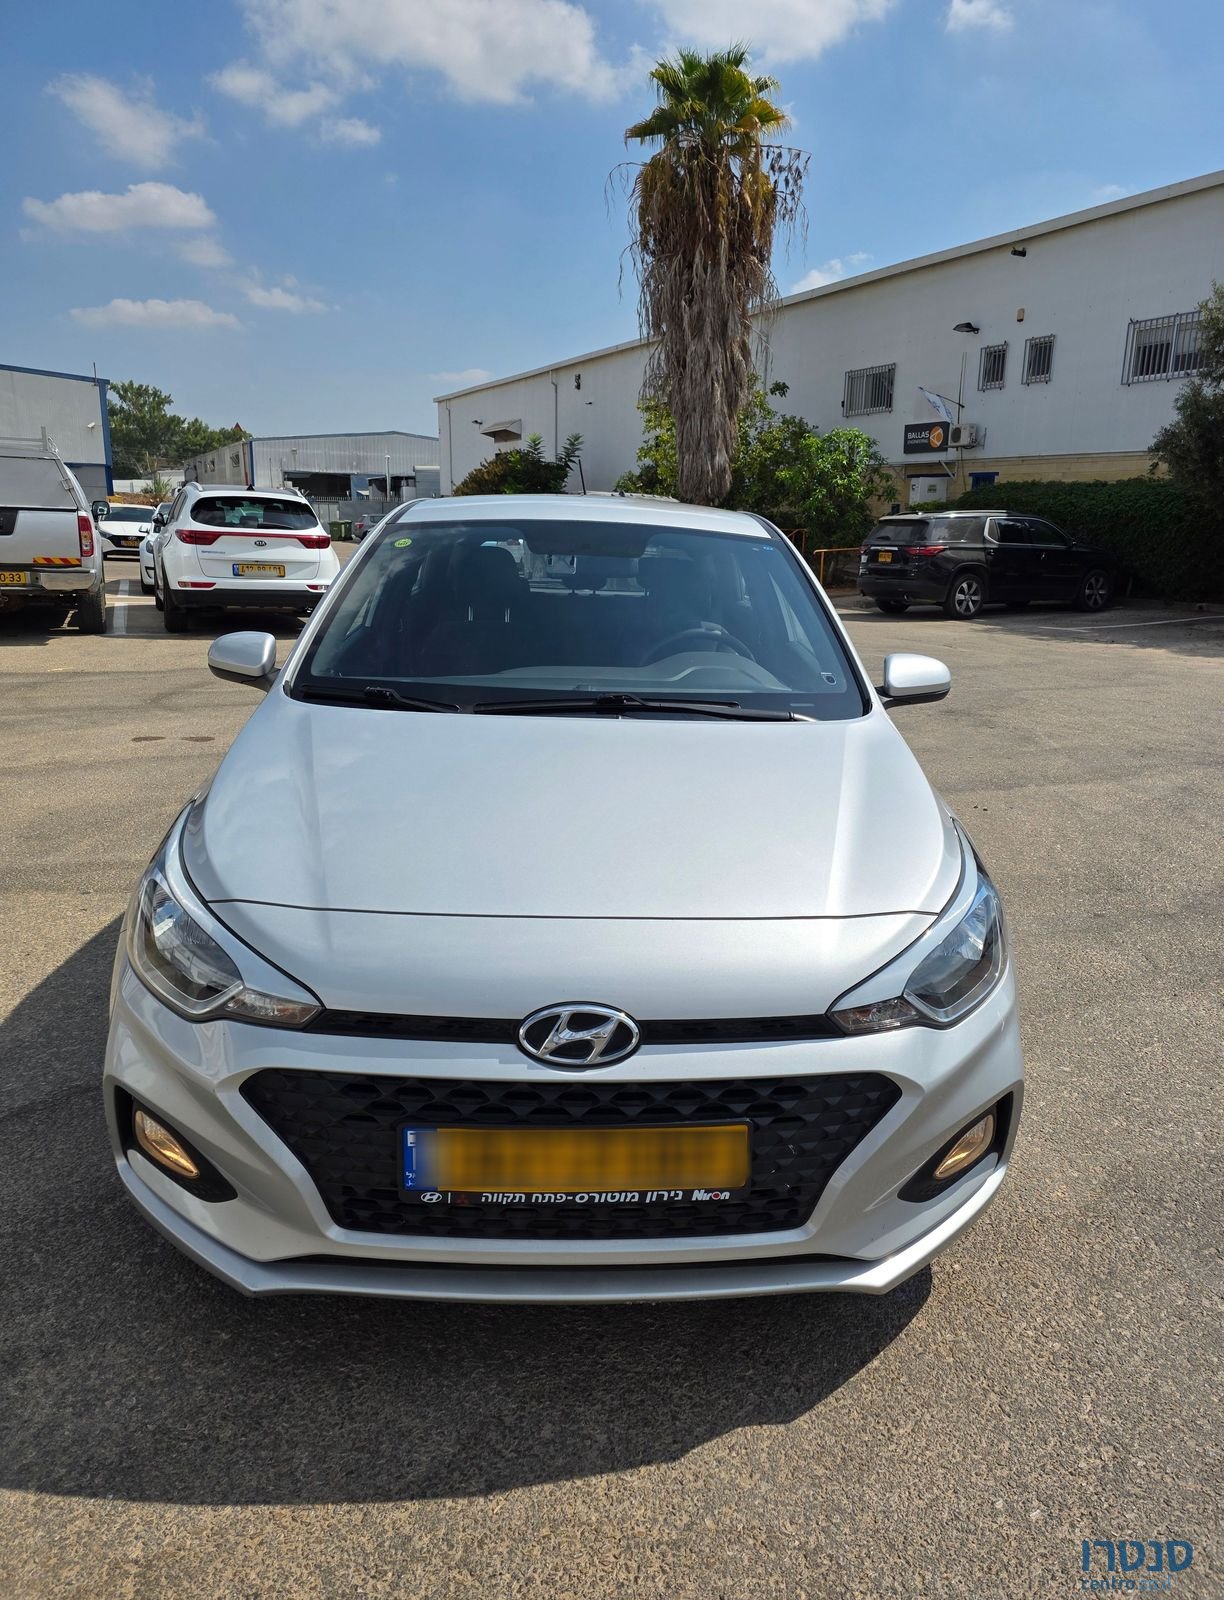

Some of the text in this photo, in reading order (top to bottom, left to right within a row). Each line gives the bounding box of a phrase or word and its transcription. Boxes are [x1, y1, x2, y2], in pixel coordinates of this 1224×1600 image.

[907, 430, 930, 440] BALLAS
[481, 1192, 526, 1204] תקווה
[645, 1190, 683, 1203] נירון
[691, 1189, 730, 1201] Niron
